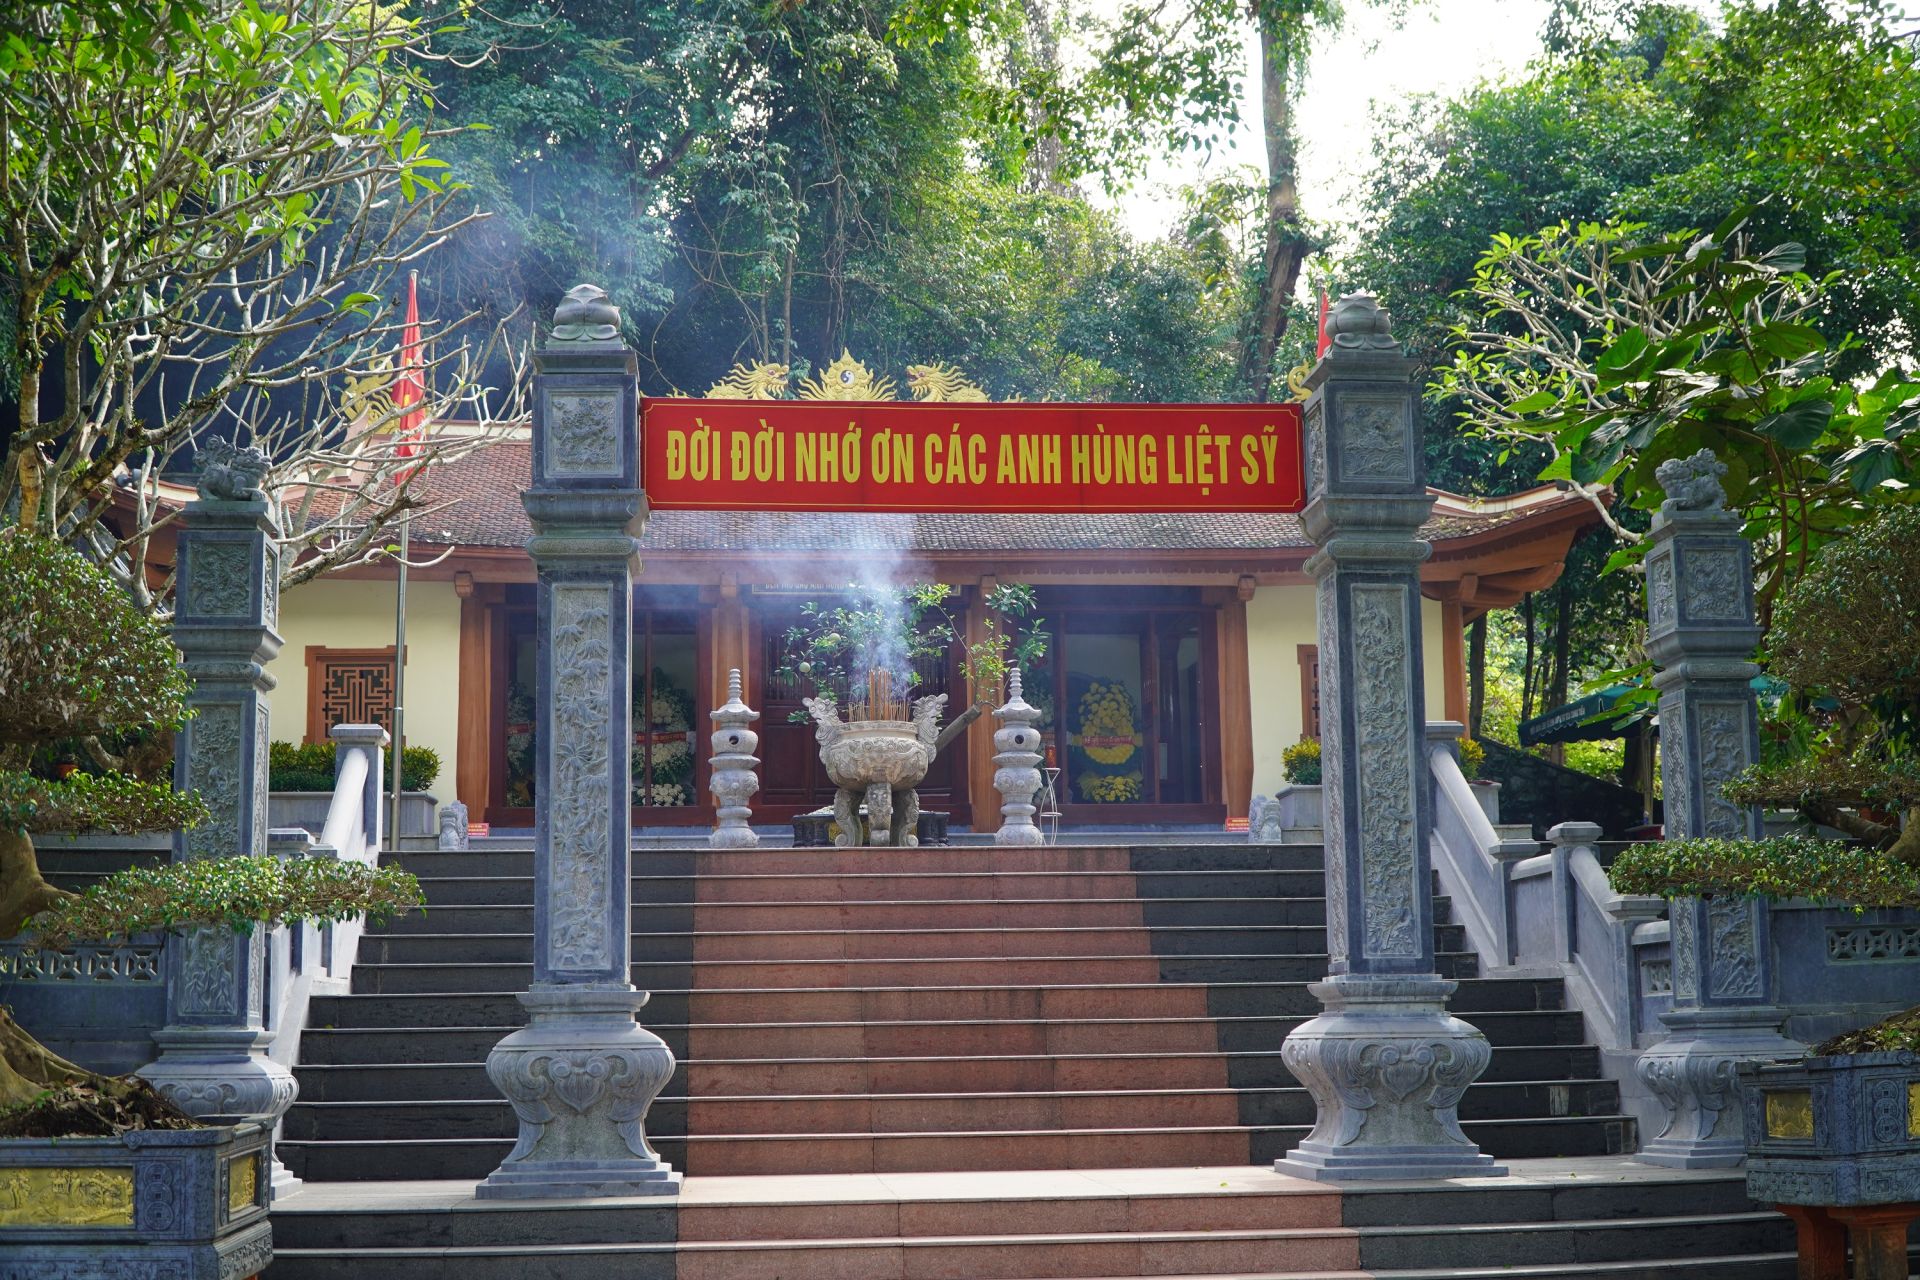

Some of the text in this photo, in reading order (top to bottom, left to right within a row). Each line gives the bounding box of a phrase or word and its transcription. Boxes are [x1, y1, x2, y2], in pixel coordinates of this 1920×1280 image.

[667, 418, 1278, 495] ĐỜI ĐỜI NHỚ ƠN CÁC ANH HÙNG LIỆT SỸ
